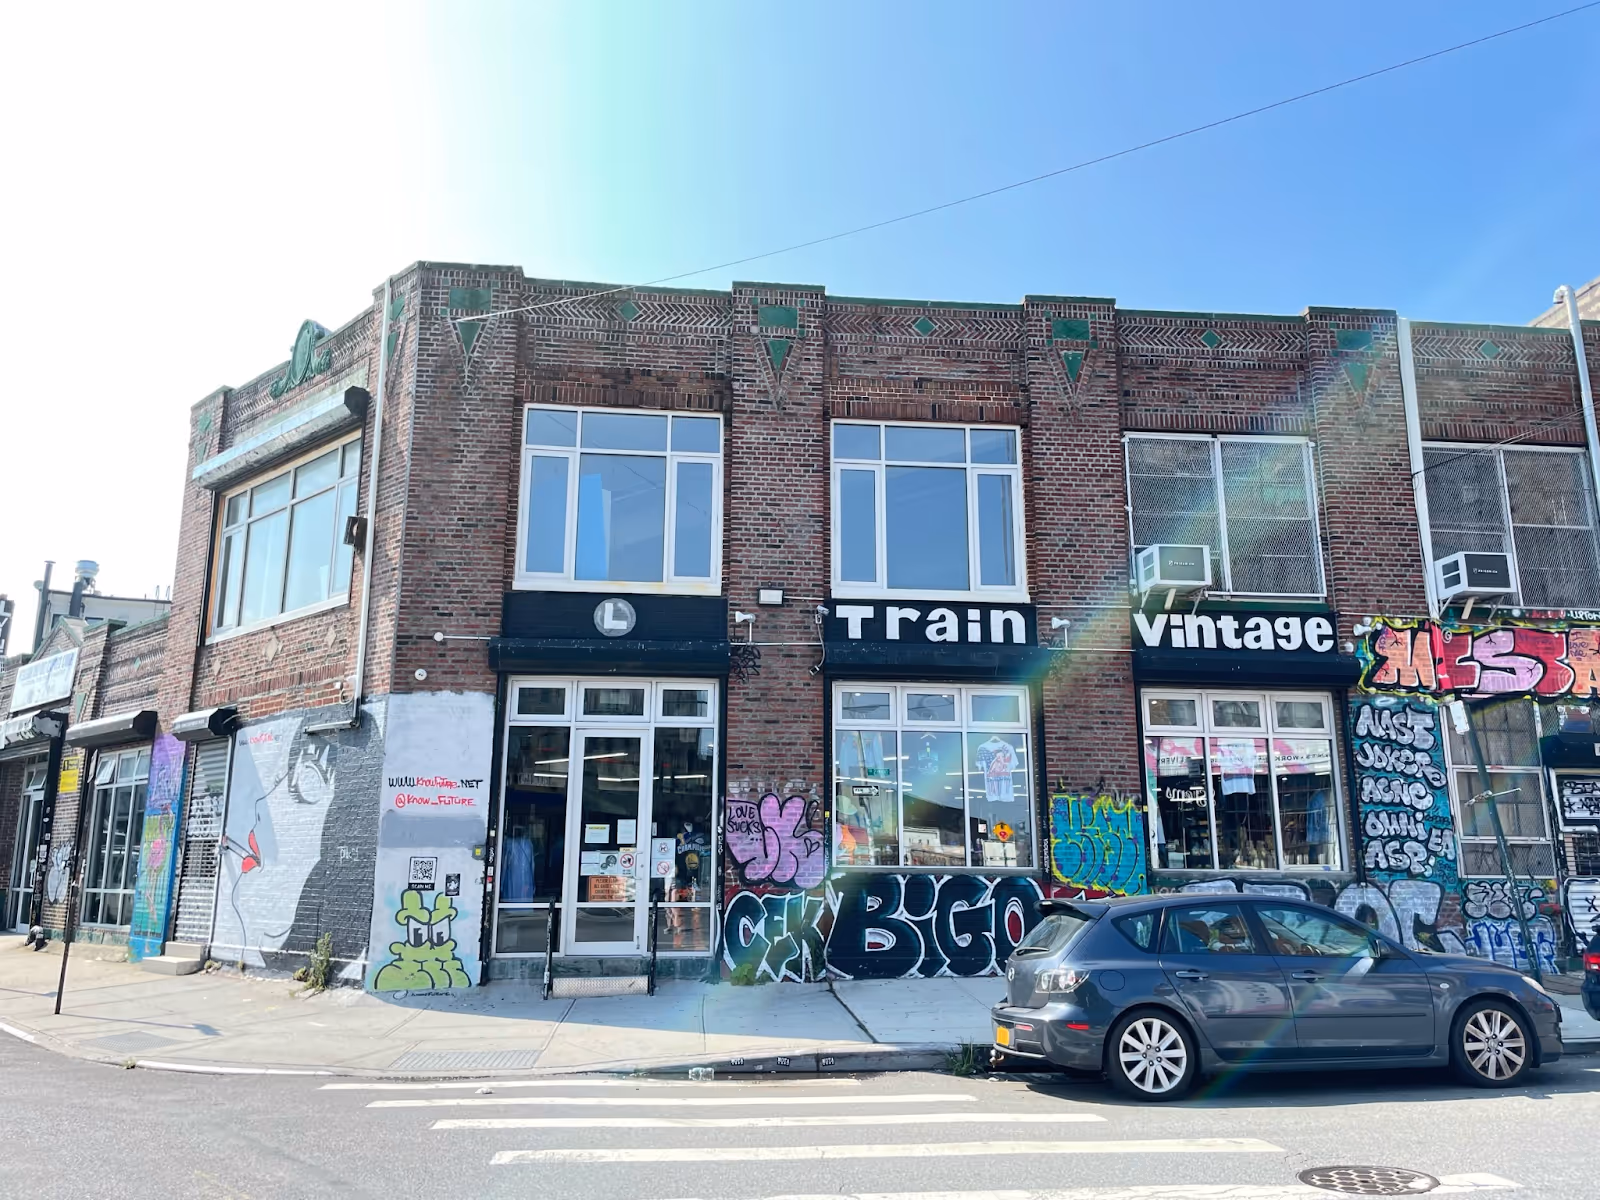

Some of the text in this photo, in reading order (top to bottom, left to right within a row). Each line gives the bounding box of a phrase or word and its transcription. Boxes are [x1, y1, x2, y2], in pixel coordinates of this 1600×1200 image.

[603, 602, 627, 630] L
[835, 605, 1026, 643] Train
[1132, 612, 1335, 652] Vintage
[728, 805, 756, 819] LOVE
[727, 819, 761, 835] SUCKS
